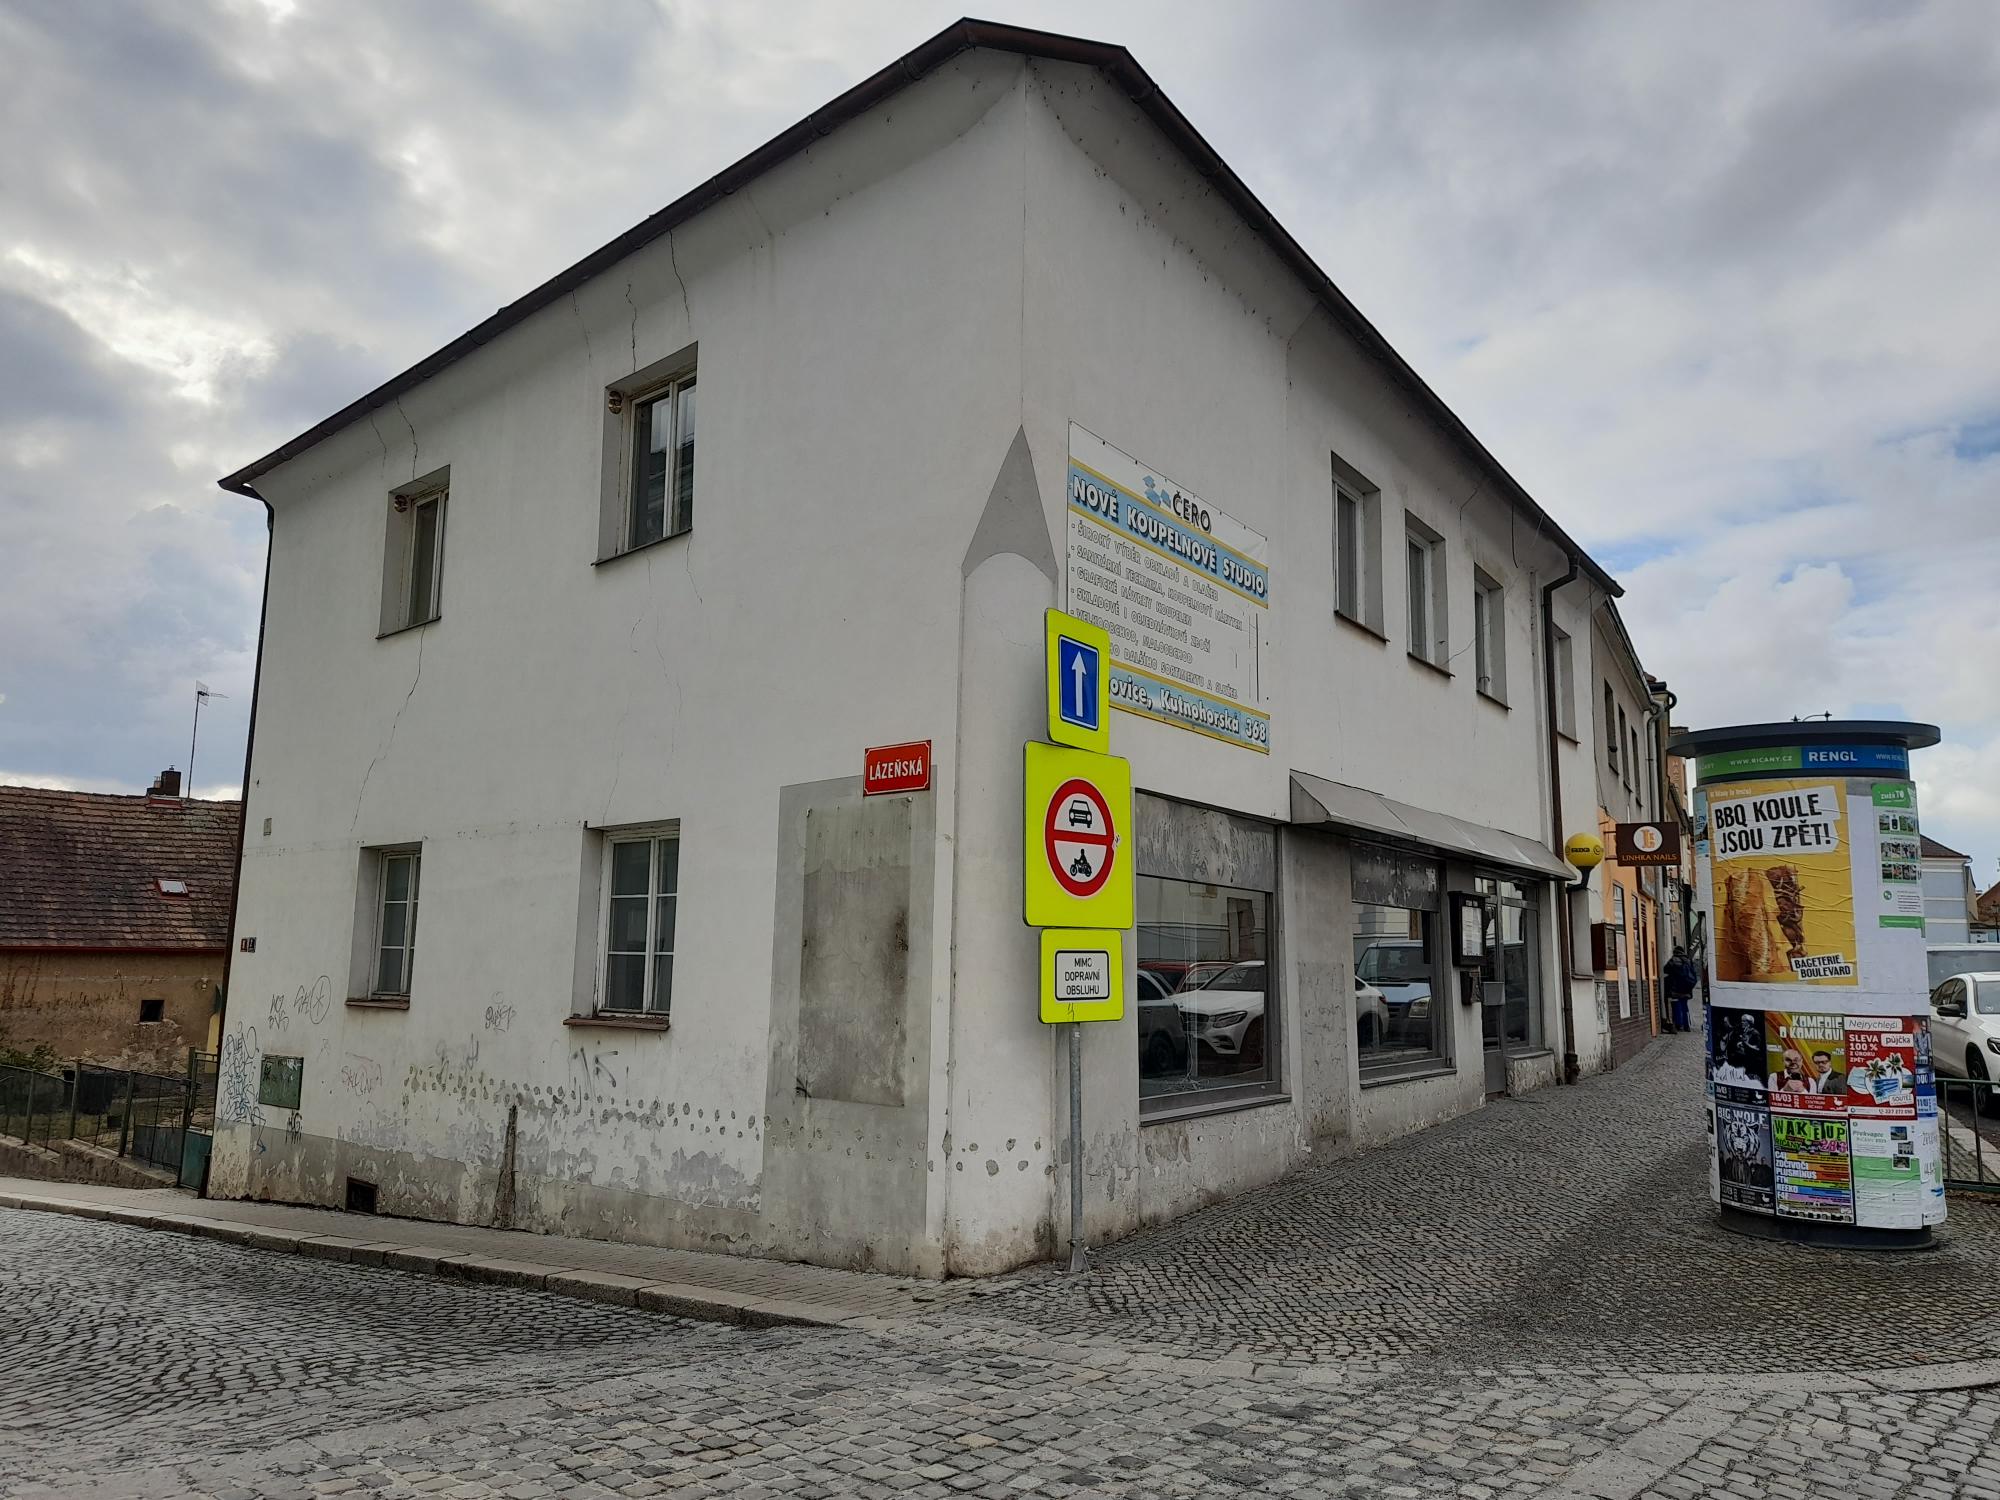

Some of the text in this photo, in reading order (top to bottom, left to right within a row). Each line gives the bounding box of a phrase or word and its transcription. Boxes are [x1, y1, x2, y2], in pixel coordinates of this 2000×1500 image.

[1173, 490, 1211, 533] ČERO
[1073, 475, 1265, 594] NOVÉ KOUPELNOVÉ STUDIO
[1077, 520, 1111, 549] ŠIROKÝ
[1114, 541, 1141, 565] VÝBĚR
[1144, 557, 1179, 582] OBKLADŮ
[1183, 576, 1189, 588] A
[1077, 545, 1121, 575] SANITÁRNÍ
[1077, 567, 1192, 626] GRAFICKÉ NÁVRHY KOUPELEN
[1077, 588, 1119, 615] SKLADOVÉ
[1143, 635, 1192, 663] MALOOBCHOD
[1124, 648, 1157, 670] DALŠÍHO
[1161, 662, 1204, 687] SORTIMENTU
[1110, 674, 1267, 742] ovice, Kutnohorská 368
[869, 756, 923, 780] LÁZEŇSKÁ
[1808, 751, 1858, 762] RENGL
[1714, 803, 1746, 829] BBQ
[1754, 794, 1822, 822] KOULE
[1719, 820, 1831, 854] JSOU ZPĚT!
[1074, 958, 1092, 968] MIMO
[1794, 955, 1841, 969] BAGETERIE
[1800, 965, 1851, 979] BOULEVARD
[1065, 969, 1100, 981] DOPRAVNÍ
[1066, 985, 1100, 995] OBSLUHU
[1790, 1026, 1844, 1040] KOMIKOVI
[1792, 1015, 1843, 1028] KOMEDIE
[1849, 1034, 1879, 1042] SLEVA
[1885, 1035, 1911, 1045] půjčka
[1717, 1106, 1766, 1125] BIG WOLF
[1774, 1119, 1846, 1141] WAKE UP
